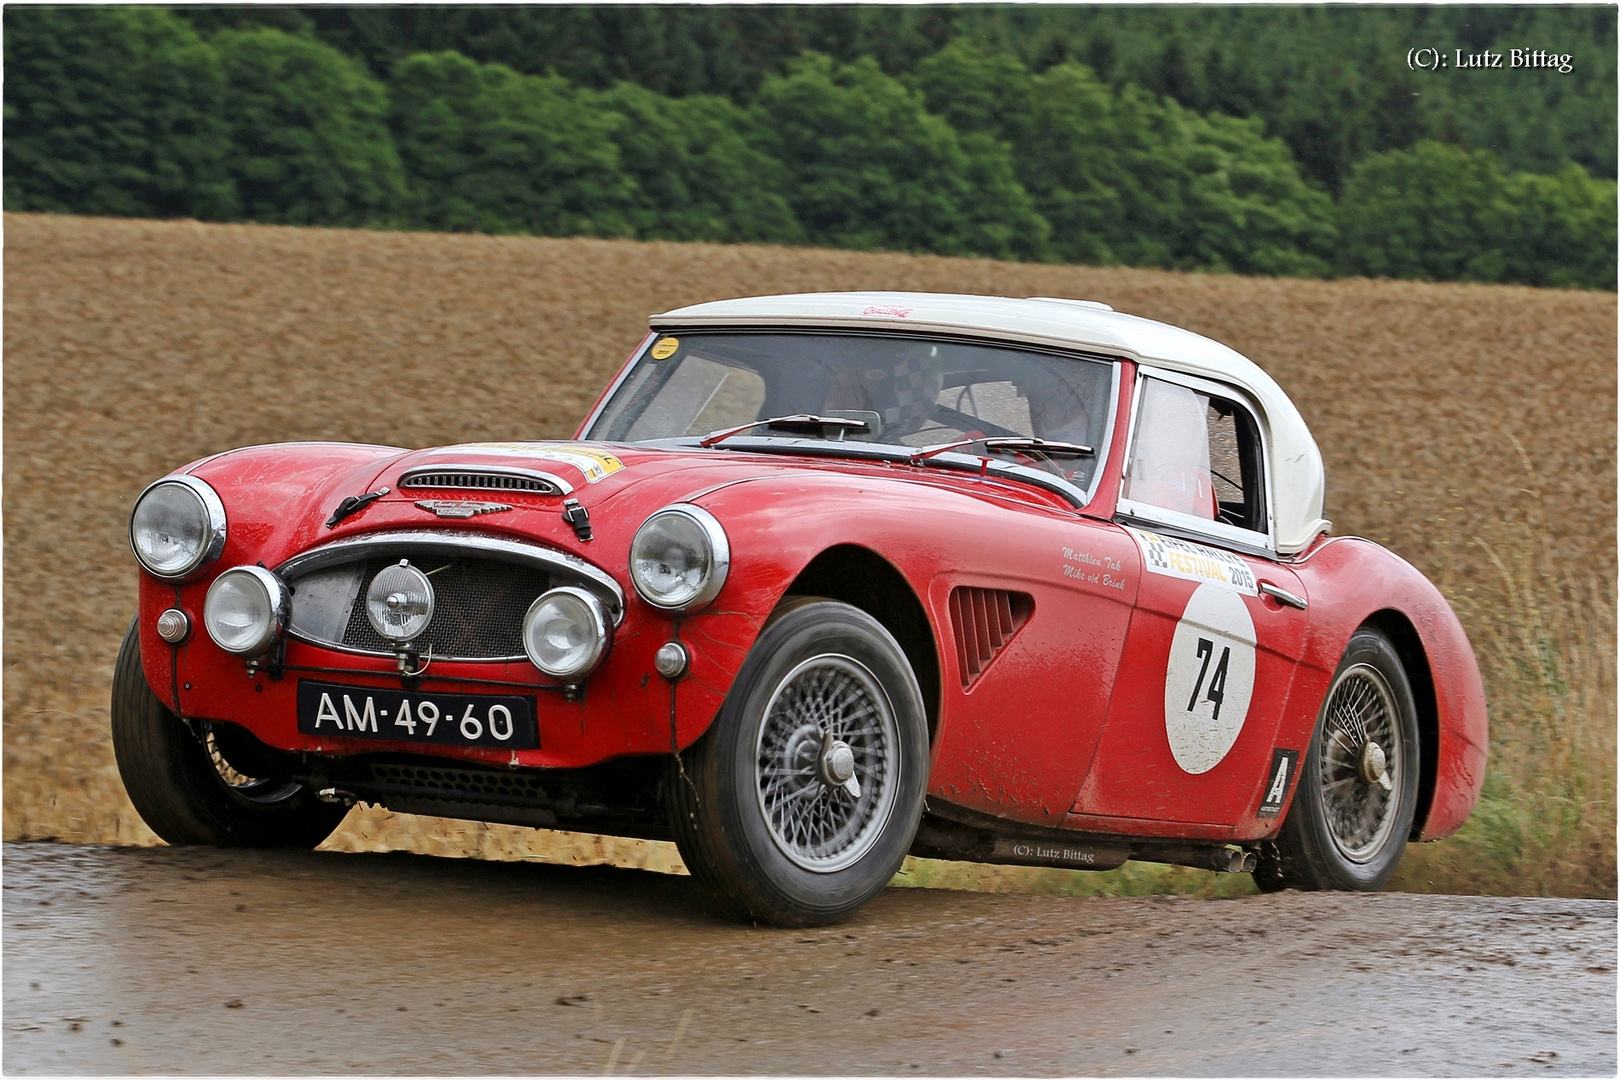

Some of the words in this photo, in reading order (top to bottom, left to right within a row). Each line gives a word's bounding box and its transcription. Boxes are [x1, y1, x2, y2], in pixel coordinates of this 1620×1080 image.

[1061, 546, 1102, 567] Matthieu
[1104, 556, 1121, 572] Tak
[1062, 564, 1086, 581] Mike
[1102, 573, 1126, 591] Brink
[1168, 550, 1228, 583] FESTIVAL
[1228, 566, 1254, 590] 2015
[1187, 637, 1230, 721] 74
[314, 692, 514, 741] AM-49-60
[1265, 756, 1289, 804] A
